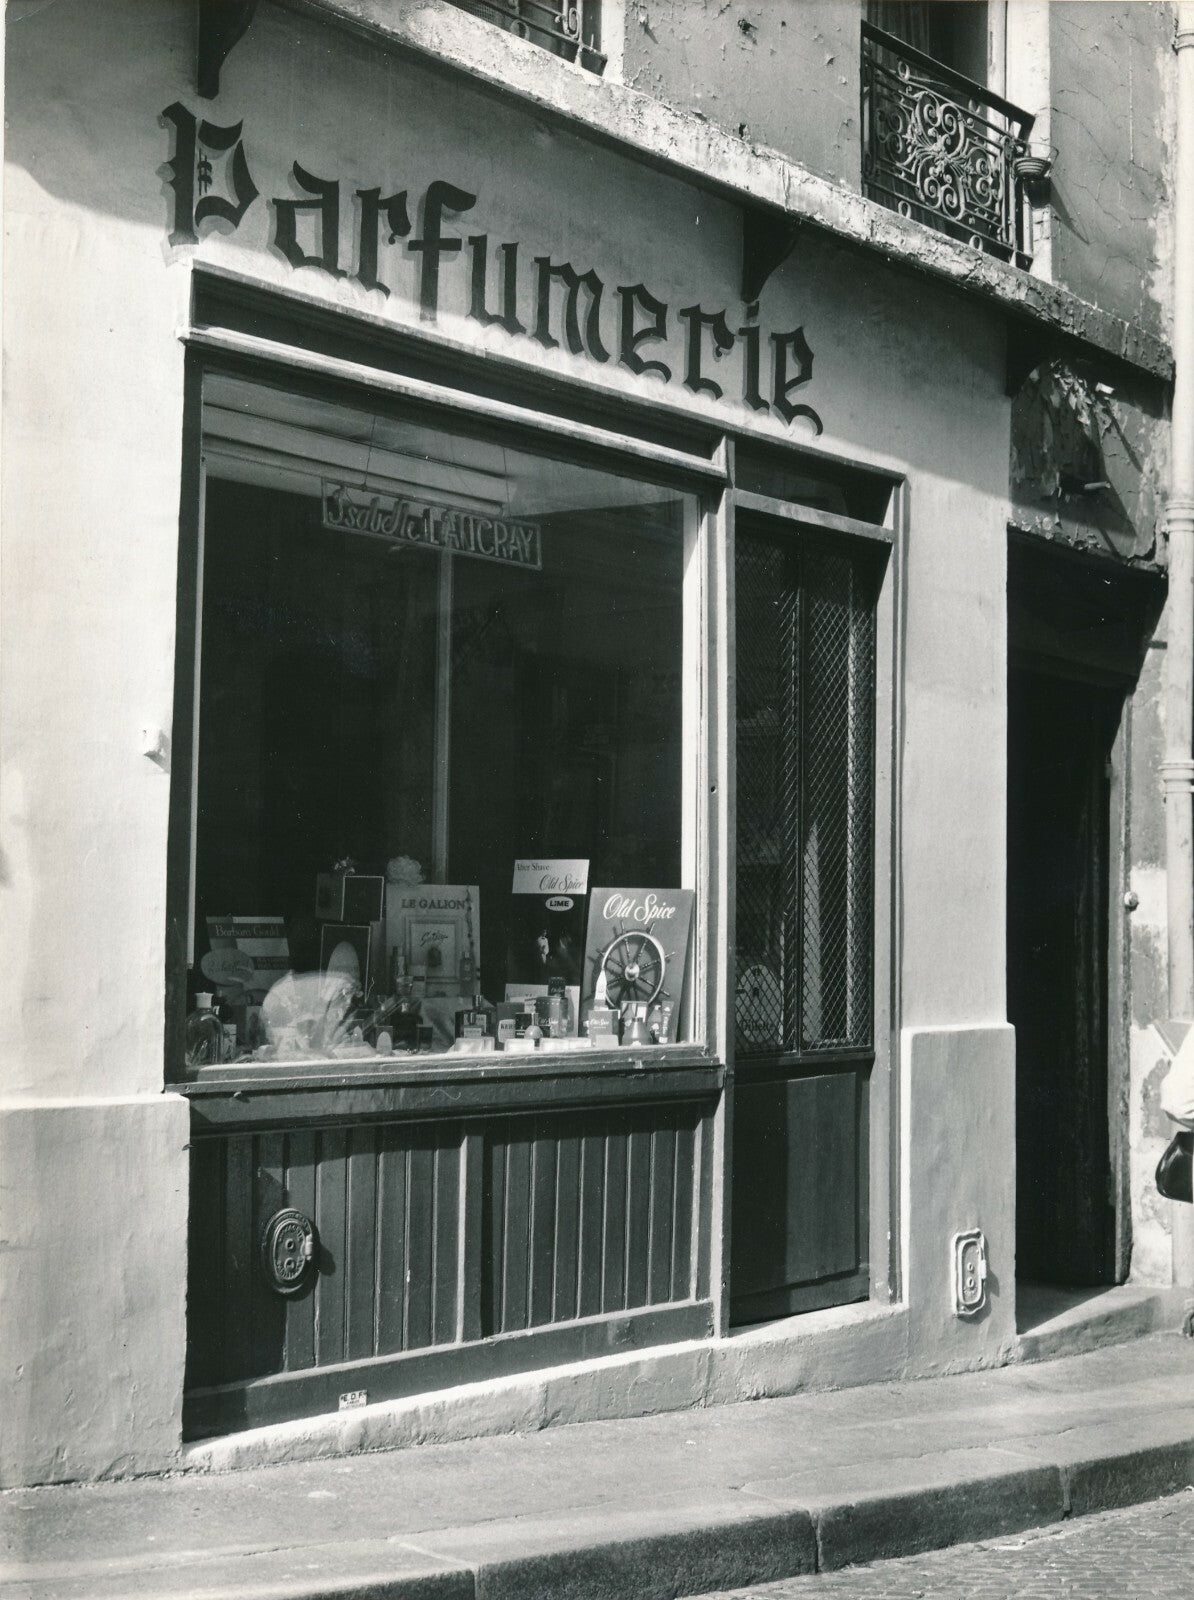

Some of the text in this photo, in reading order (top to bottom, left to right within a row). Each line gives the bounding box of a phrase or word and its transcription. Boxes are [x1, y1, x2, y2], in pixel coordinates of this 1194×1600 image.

[162, 101, 824, 437] Parfumerie
[531, 862, 550, 872] Shave
[539, 873, 584, 893] Old Spice
[401, 898, 466, 910] LE GALION
[550, 900, 570, 908] LIME
[603, 893, 676, 925] Old Spice
